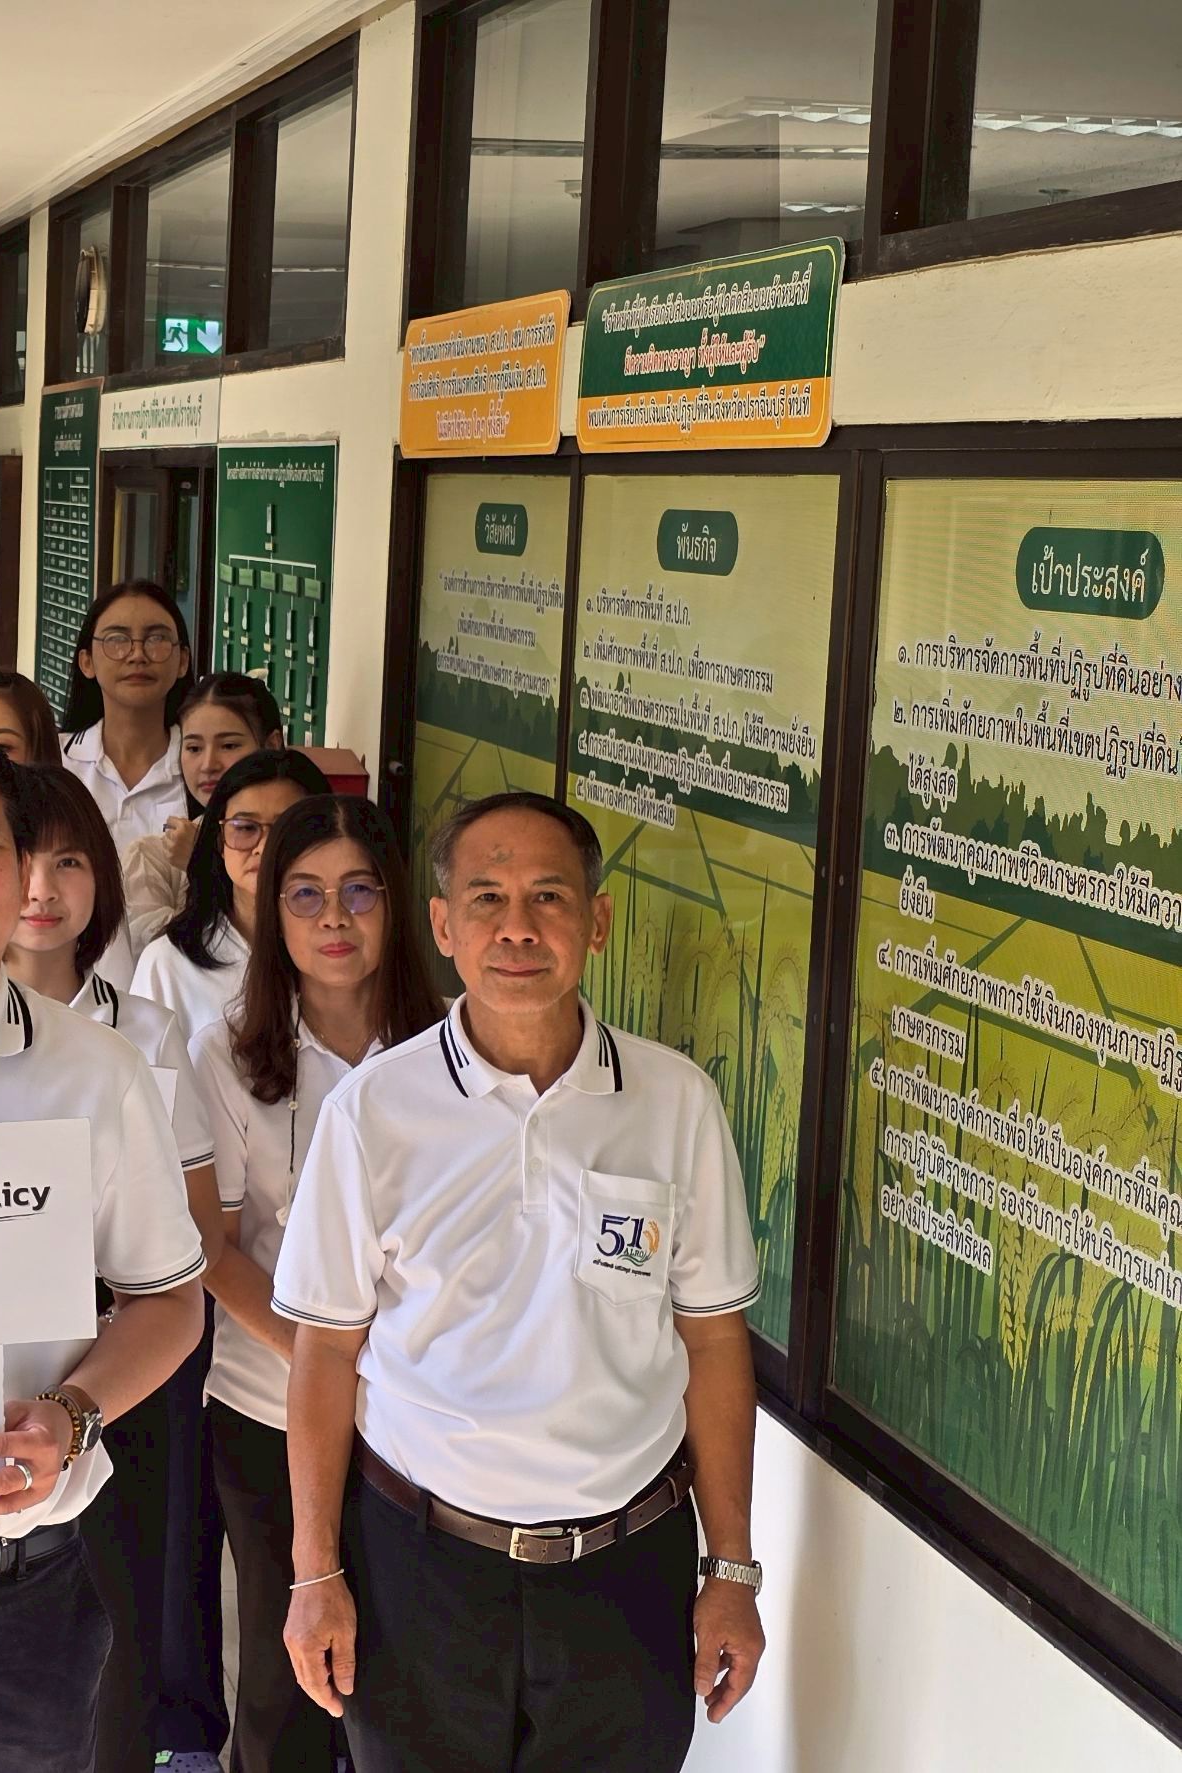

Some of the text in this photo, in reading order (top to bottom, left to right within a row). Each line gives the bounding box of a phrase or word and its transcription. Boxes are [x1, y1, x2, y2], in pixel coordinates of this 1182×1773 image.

[788, 382, 811, 417] ทันที
[485, 514, 517, 546] วิสัยทัศน์
[677, 523, 717, 563] พันธกิจ
[1032, 545, 1150, 602] เป้าประสงค์
[596, 584, 664, 622] บริหารจัดการพื้นที่
[665, 600, 691, 626] ส.ป.ก.
[594, 629, 658, 671] เพิ่มศักยภาพพื้นที่
[660, 648, 685, 676] ส.ป.ก.
[687, 644, 774, 694] เพื่อการเกษตรกรรม
[898, 630, 1182, 702] ๑. การบริหารจัดการพื้นที่ปฏิรูปที่ดินอย่าง
[713, 711, 740, 742] ส.ป.ก.
[744, 710, 816, 760] ให้มีความยั่งยืน
[893, 689, 1182, 780] ๒. การเพิ่มศักยภาพในพื้นที่เขตปฏิรูปที่ดิน
[586, 772, 675, 828] พัฒนาองค์การให้ทันสมัย
[909, 754, 956, 810] ได้สูงสุด
[886, 829, 899, 847] ๓.
[901, 870, 933, 920] ยั่งยืน
[879, 944, 891, 967] ๔.
[892, 1010, 964, 1059] เกษตรกรรม
[871, 1062, 884, 1086] ๕.
[885, 1129, 994, 1205] การปฏิบัติราชการ
[596, 1213, 645, 1257] 51
[883, 1186, 991, 1270] อย่างมีประสิทธิผล
[624, 1248, 644, 1258] ALRO
